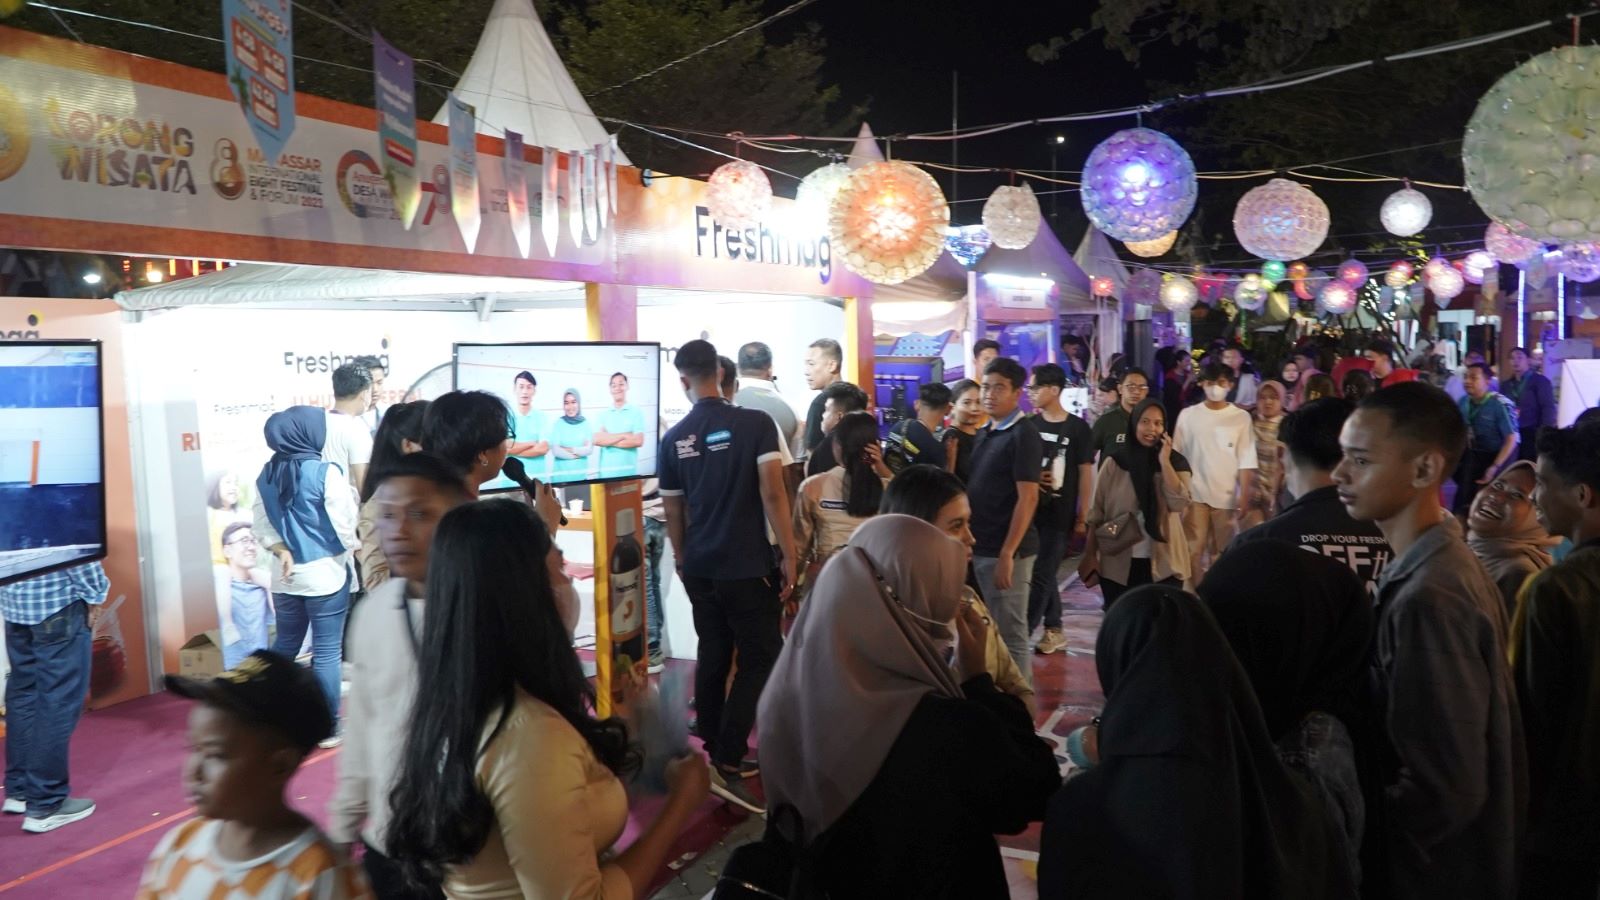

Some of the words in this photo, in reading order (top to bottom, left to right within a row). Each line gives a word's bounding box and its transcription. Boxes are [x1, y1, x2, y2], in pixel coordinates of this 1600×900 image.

[48, 96, 194, 157] LORONG
[50, 143, 197, 195] WISATA
[249, 175, 278, 190] EIGHT
[280, 179, 323, 196] FESTIVAL
[259, 189, 299, 205] FORUM
[1300, 534, 1329, 544] DROP
[1330, 535, 1358, 544] YOUR
